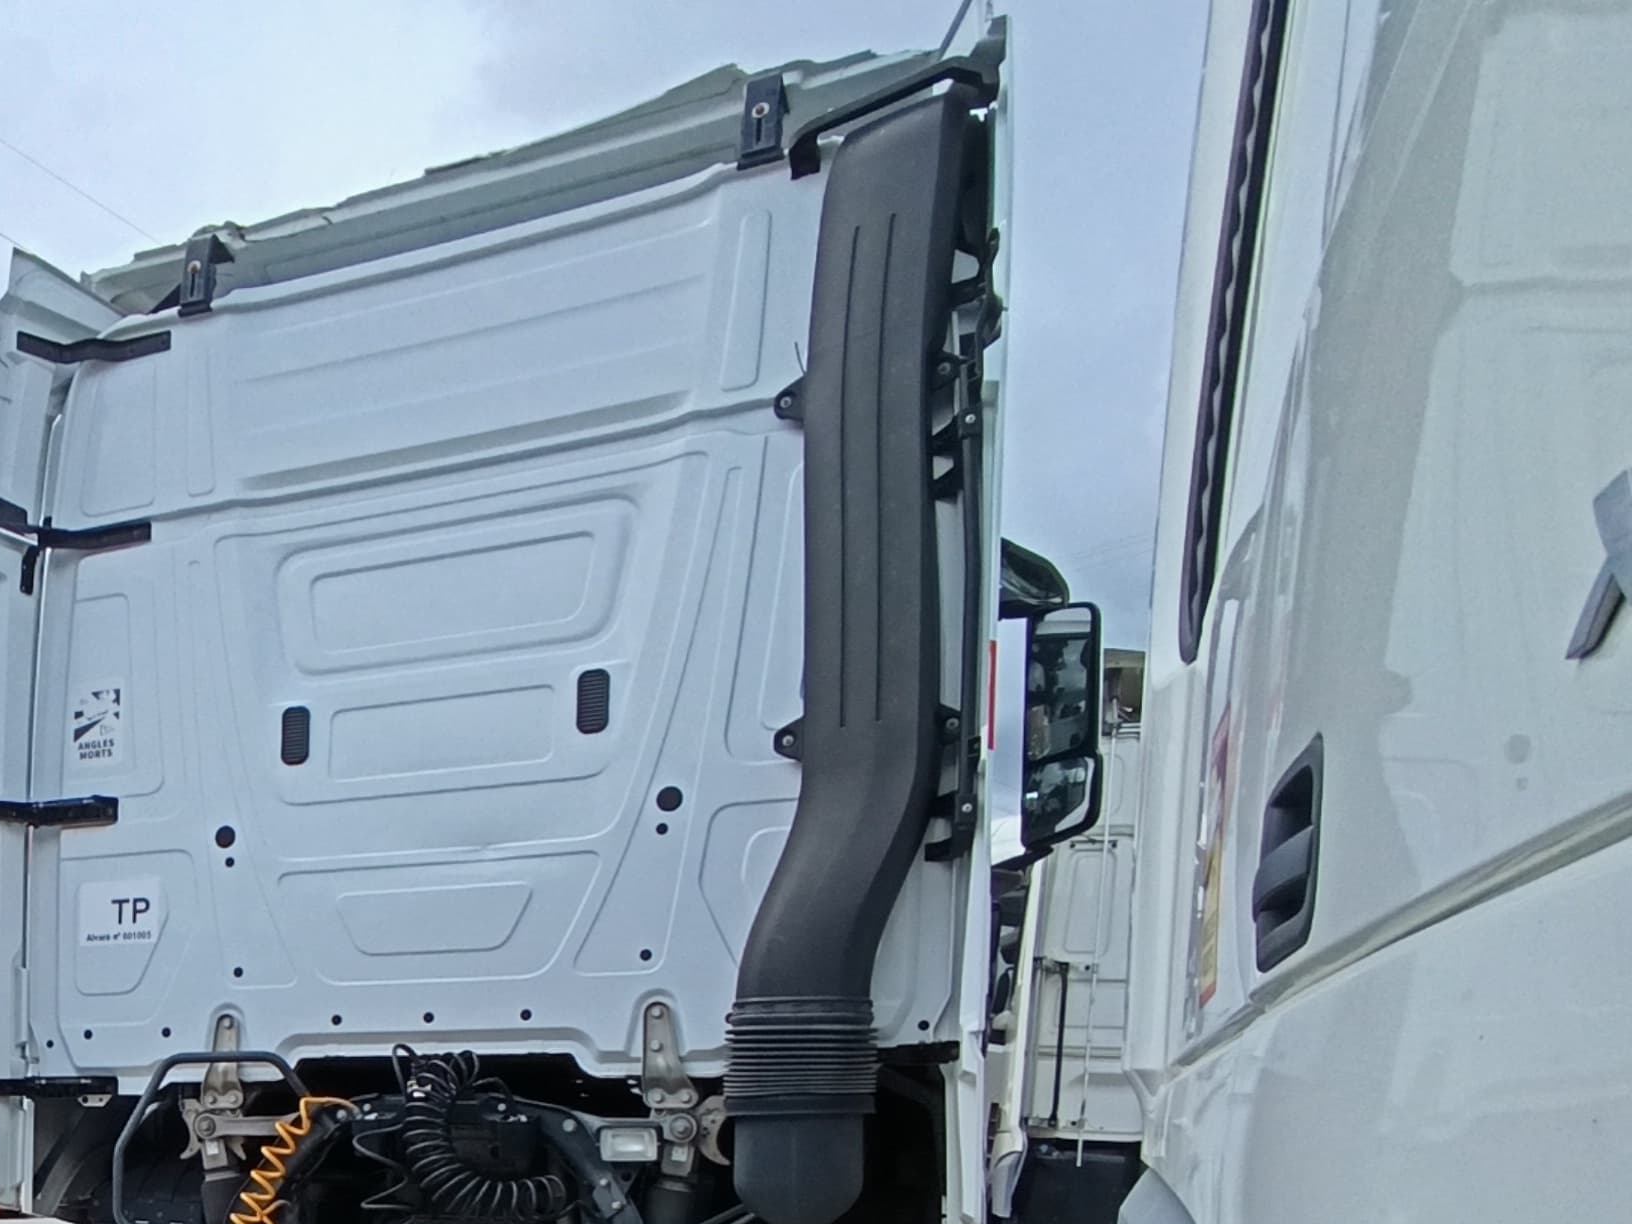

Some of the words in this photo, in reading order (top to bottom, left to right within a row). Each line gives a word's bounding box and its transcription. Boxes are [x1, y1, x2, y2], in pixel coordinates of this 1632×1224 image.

[77, 739, 115, 751] ANGLES
[79, 749, 113, 760] MORTS
[111, 897, 150, 925] TP
